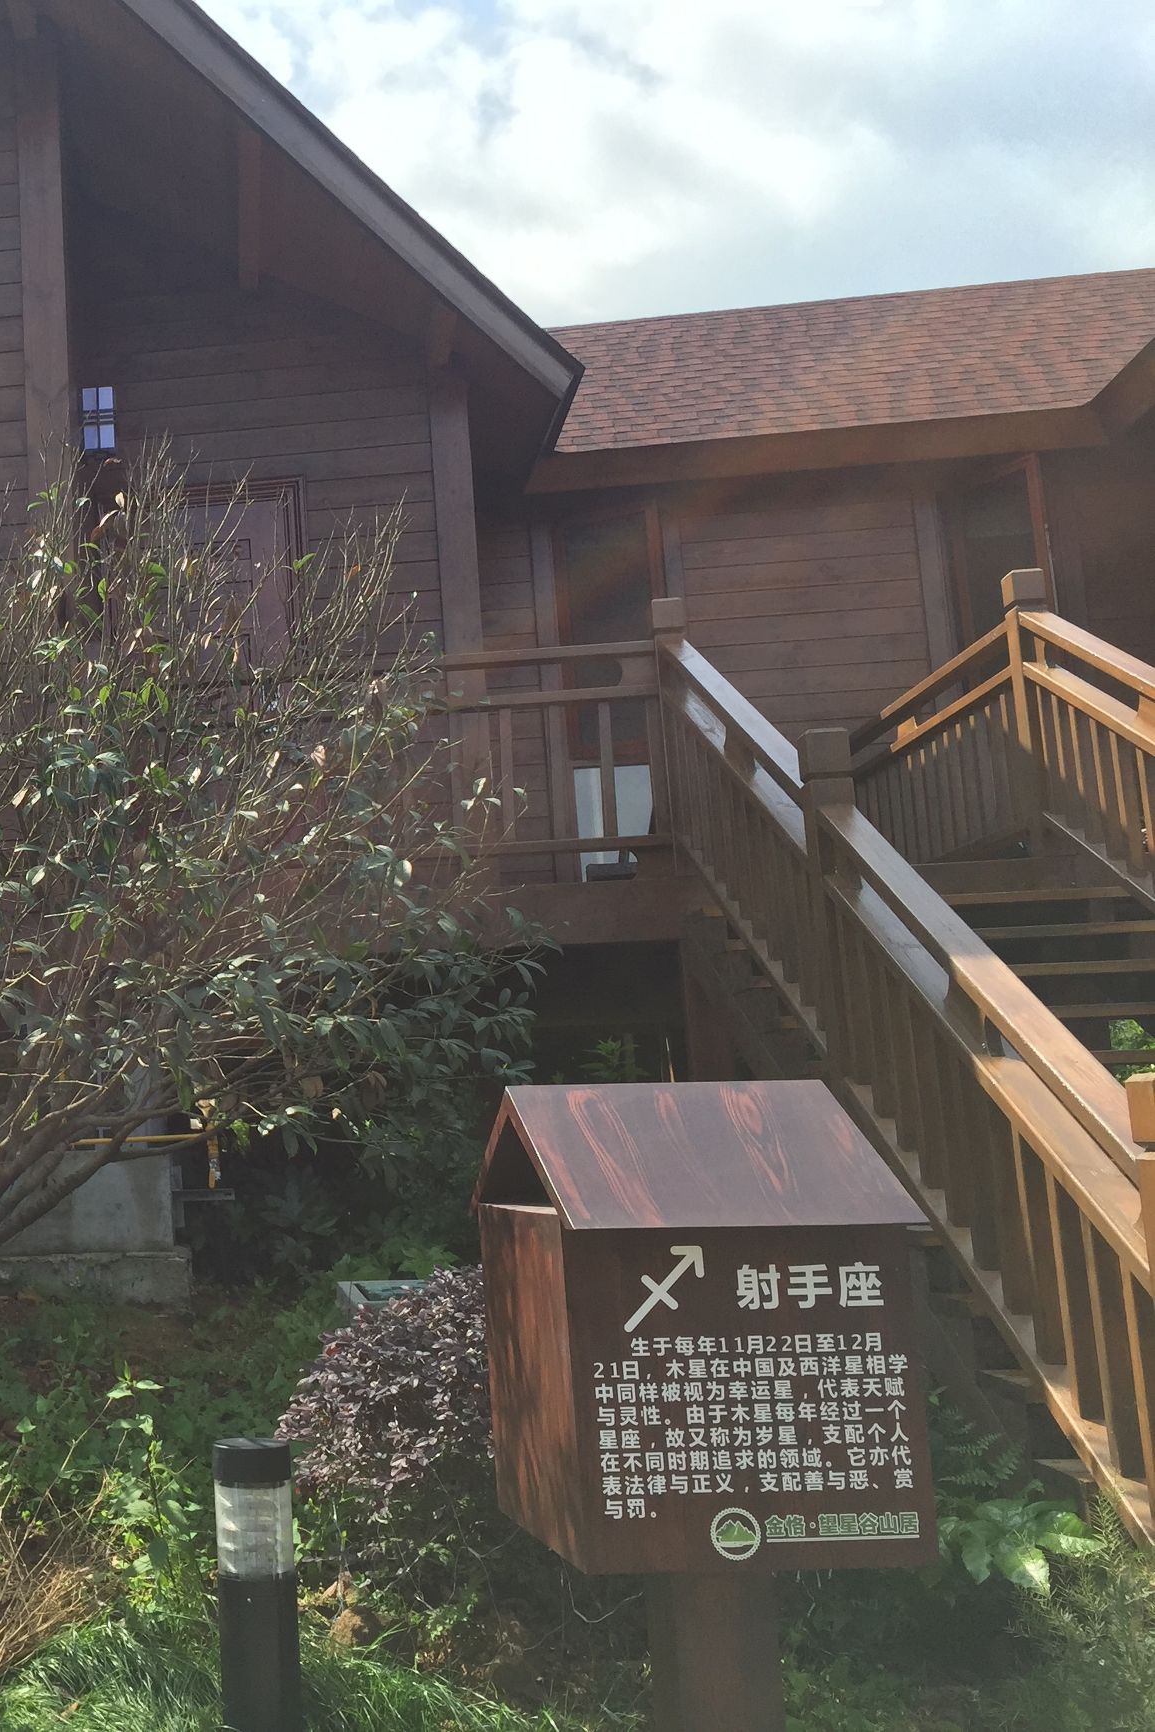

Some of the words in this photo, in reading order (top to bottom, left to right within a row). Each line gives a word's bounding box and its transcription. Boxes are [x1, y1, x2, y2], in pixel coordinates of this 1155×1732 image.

[736, 1262, 885, 1310] 射手座
[630, 1333, 883, 1357] 生于每年11月22日至12月
[595, 1377, 906, 1405] 中同样被视为幸运星，代表天赋
[597, 1399, 907, 1427] 与灵性。由于木星每年经过一个
[599, 1422, 910, 1450] 星座，故又称为岁星，支配个人
[600, 1445, 913, 1473] 在不同时期追求的领域。它亦代
[602, 1468, 914, 1496] 表法律与正义，支配善与恶、赏
[604, 1498, 658, 1520] 与罚。
